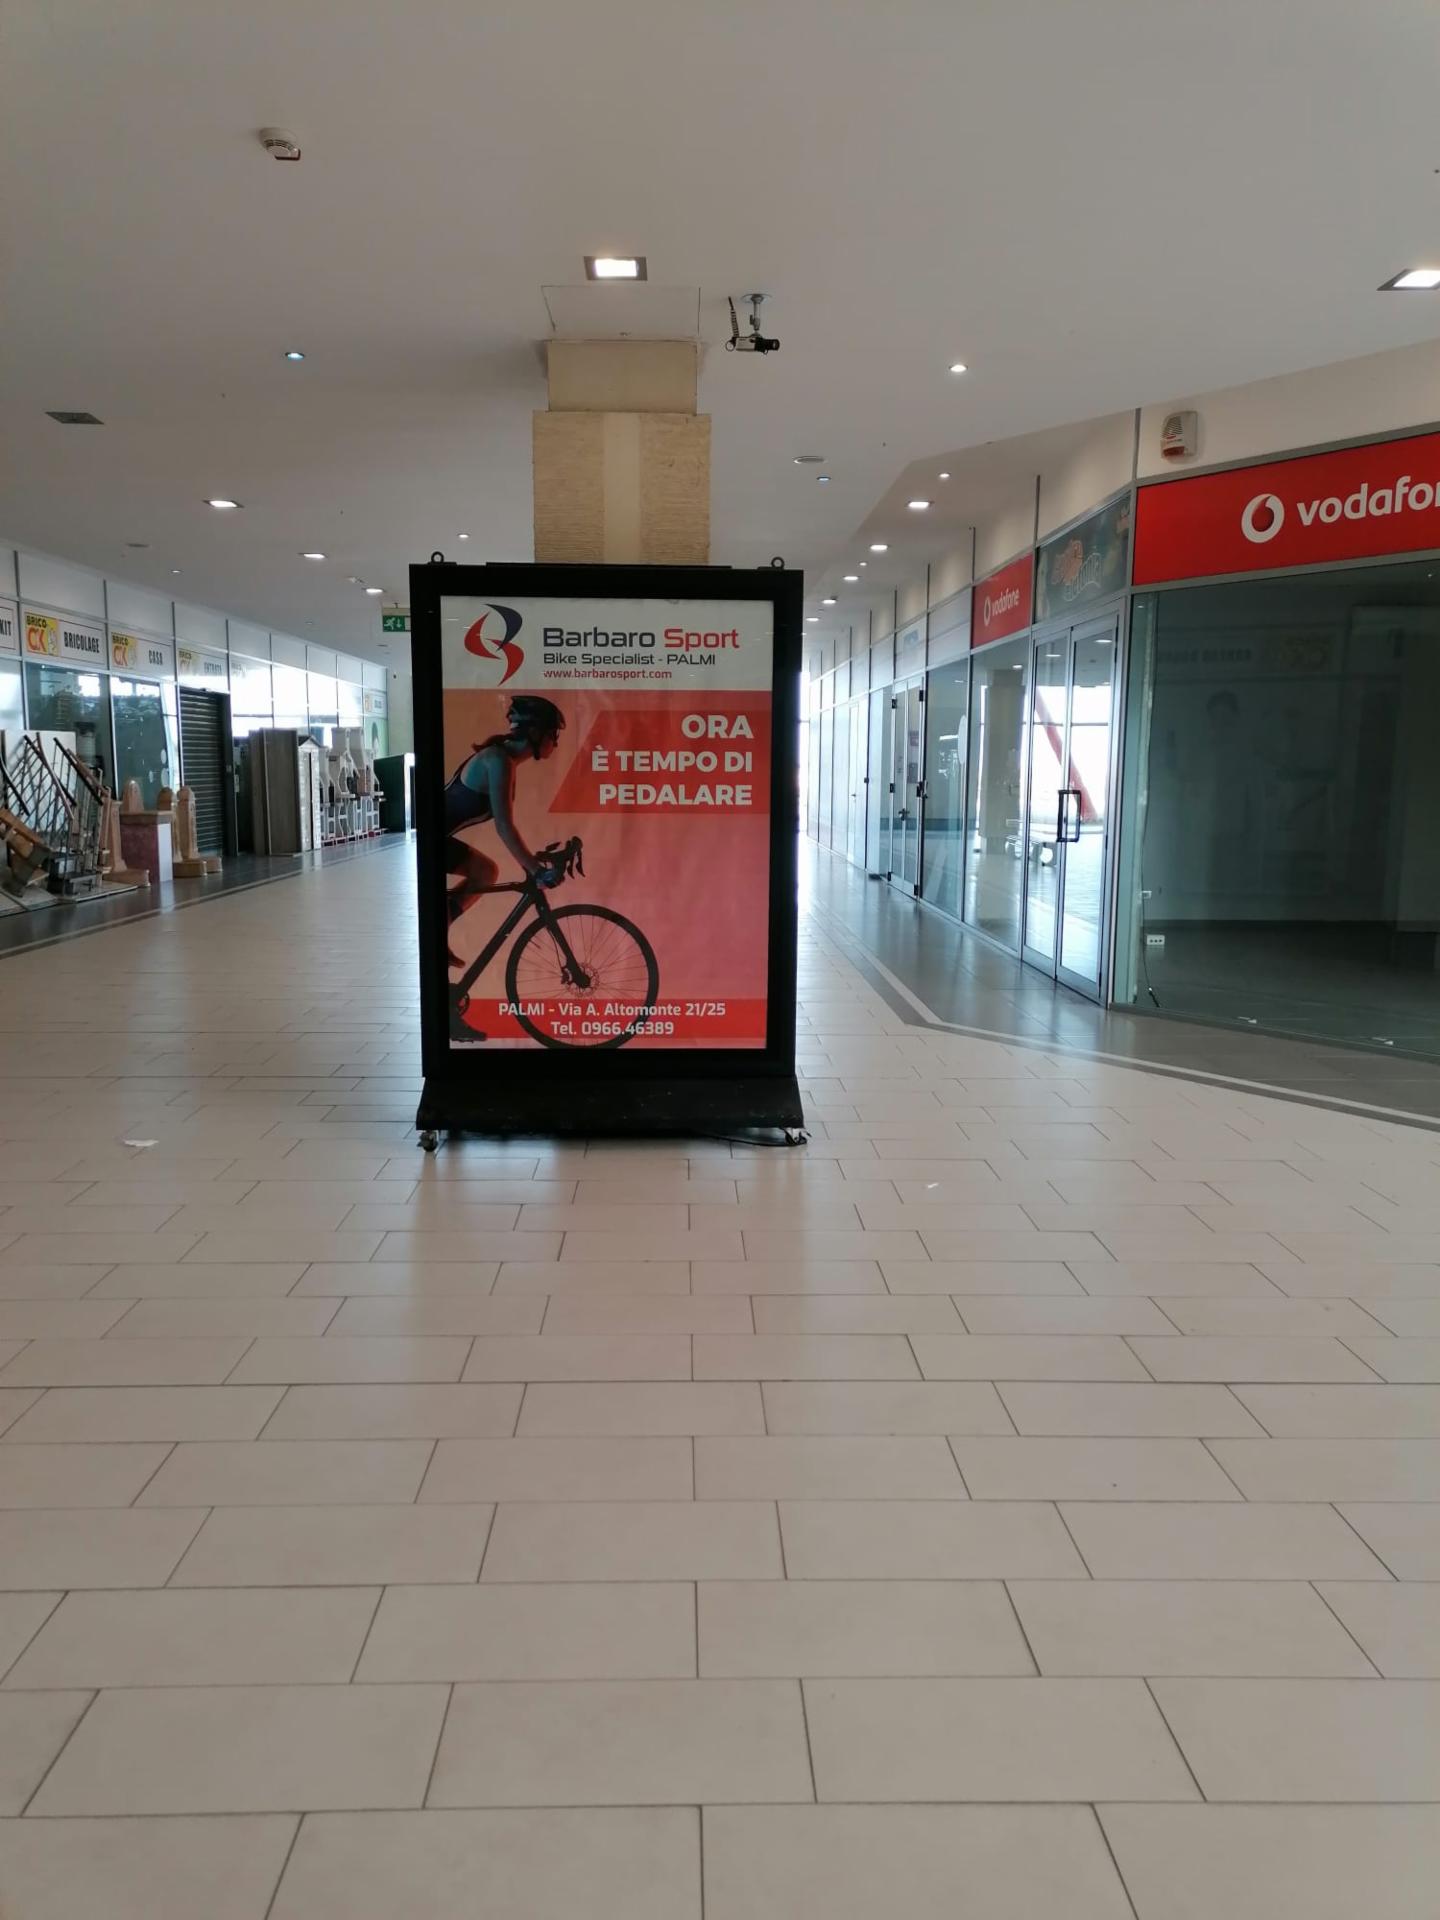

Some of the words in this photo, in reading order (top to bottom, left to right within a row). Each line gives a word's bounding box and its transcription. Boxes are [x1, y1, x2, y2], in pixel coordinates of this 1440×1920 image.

[1297, 475, 1440, 527] vodafo
[992, 588, 1020, 617] vodafone
[26, 615, 47, 628] BRICO
[63, 631, 100, 653] BRICOLAGE
[543, 626, 656, 648] Barbaro
[664, 628, 740, 651] Sport
[543, 653, 577, 665] Bike
[581, 652, 655, 667] Specialist
[666, 653, 716, 665] PALMI
[543, 668, 672, 681] www.barbarosport.com
[681, 714, 754, 740] ORA
[591, 745, 609, 772] È
[615, 750, 718, 773] TEMPO
[724, 751, 753, 773] DI
[599, 783, 753, 806] PEDALARE
[498, 1002, 545, 1016] PALMI
[558, 1002, 582, 1016] Via
[585, 1002, 600, 1016] A.
[604, 1002, 681, 1016] Altomonte
[685, 1002, 727, 1017] 21/25
[551, 1021, 577, 1035] Tel.
[581, 1021, 675, 1036] 0966.46389
